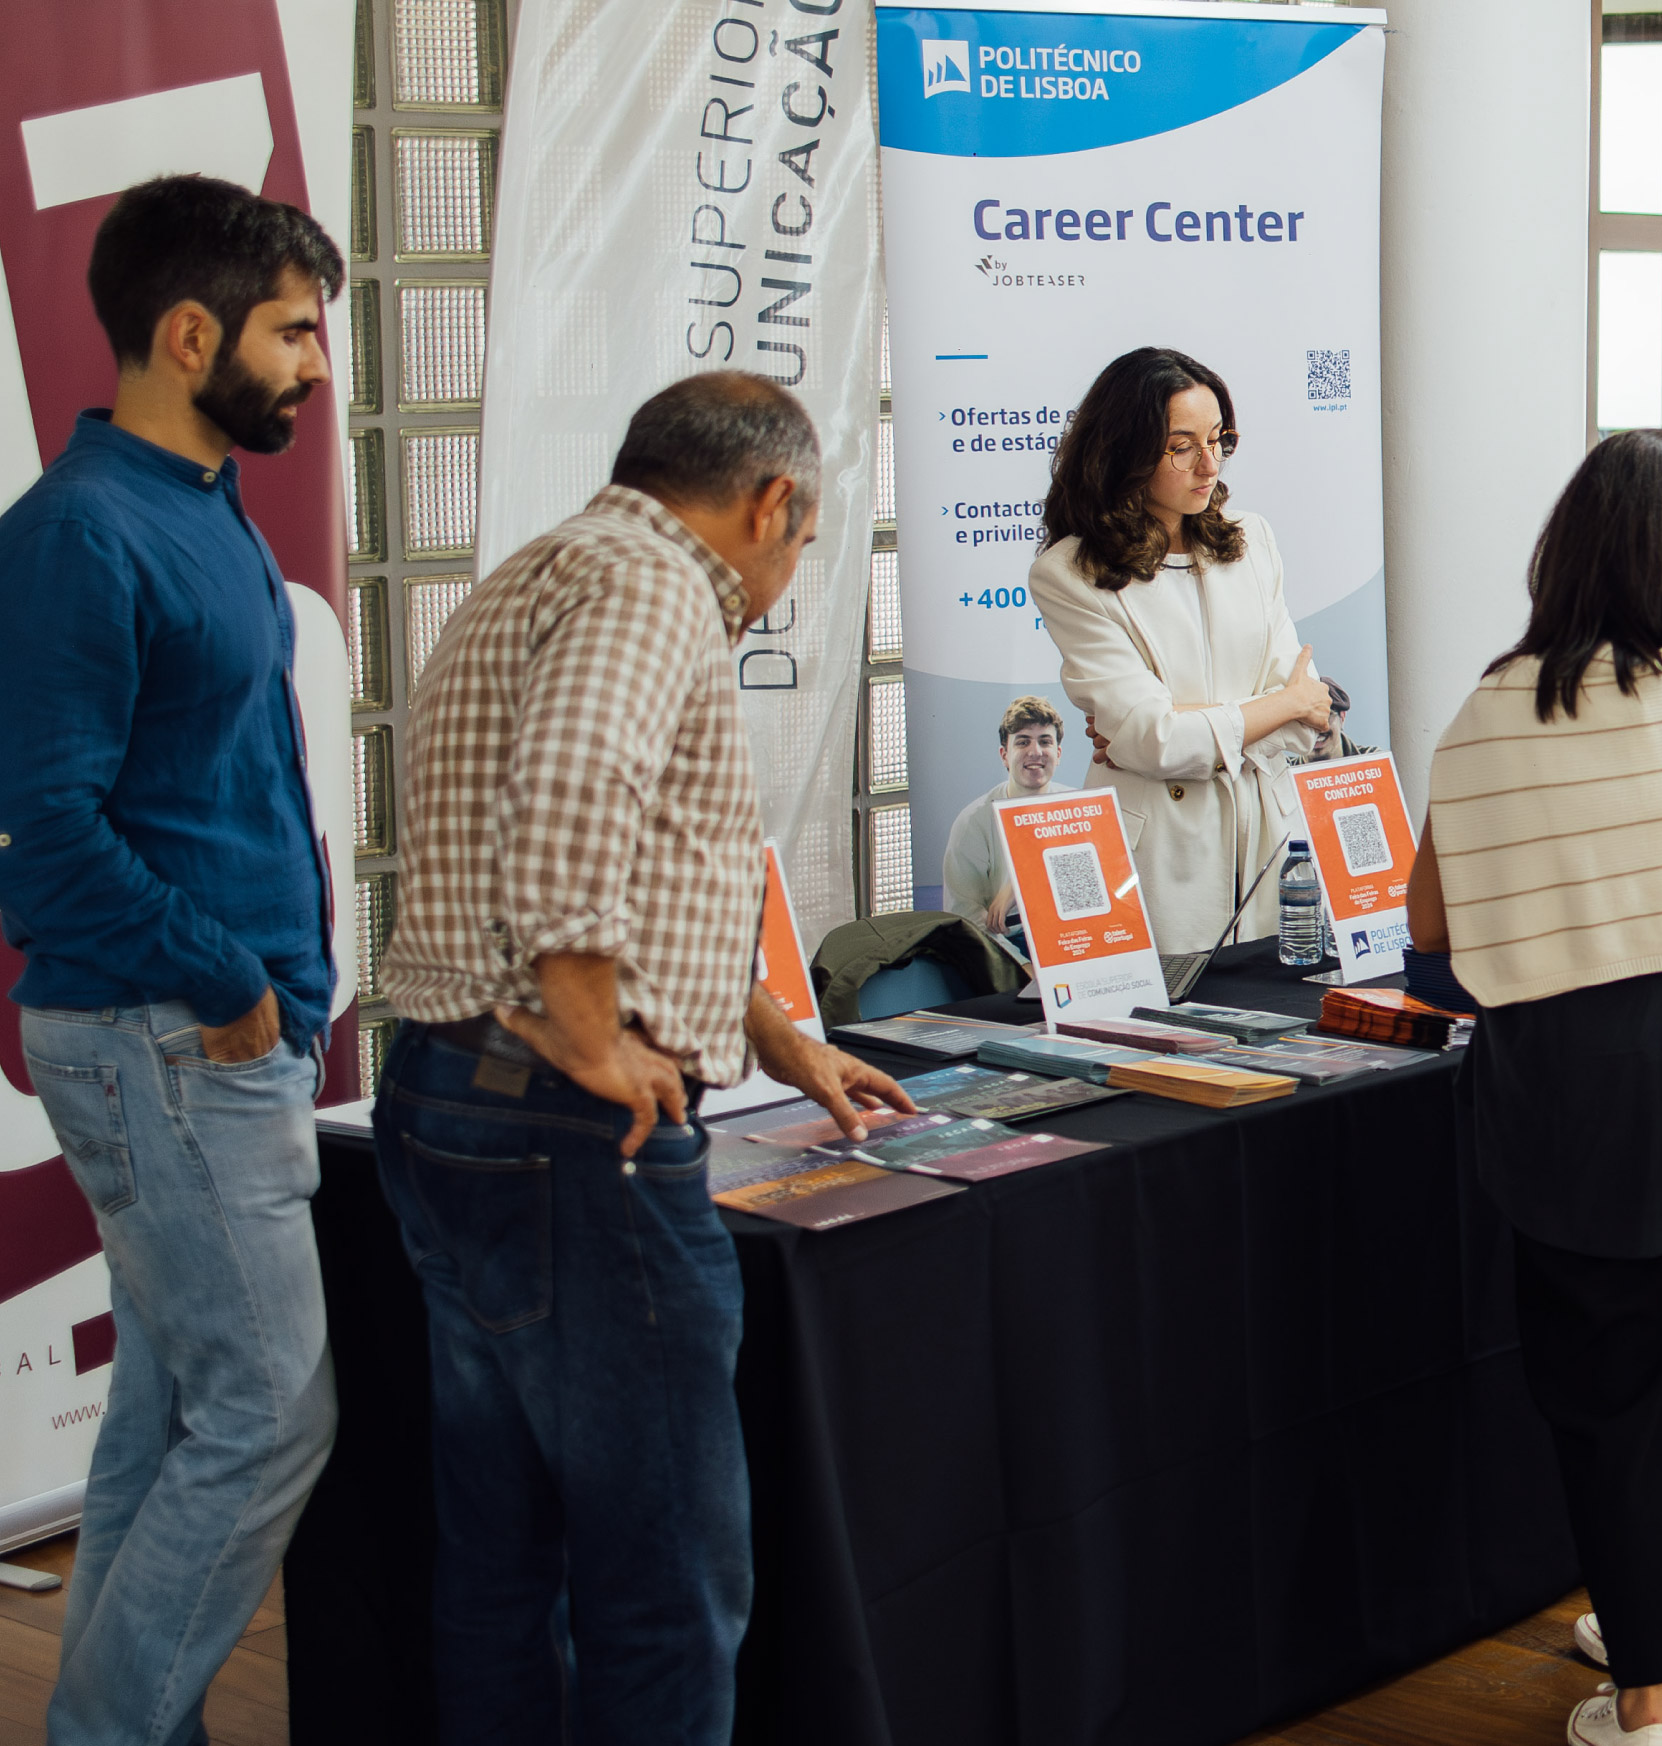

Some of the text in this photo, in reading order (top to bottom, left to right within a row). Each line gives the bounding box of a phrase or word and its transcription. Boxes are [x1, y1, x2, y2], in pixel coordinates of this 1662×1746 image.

[979, 43, 1142, 73] POLITÉCNICO
[981, 75, 1110, 100] DE LISBOA
[687, 0, 764, 362] SUPERIO
[757, 0, 843, 387] UNICAÇÃ
[973, 199, 1304, 243] Career Center
[995, 259, 1008, 271] by
[992, 274, 1086, 287] JOBTEASER
[951, 407, 1031, 426] Ofertas
[1036, 406, 1061, 424] de
[952, 438, 965, 453] e
[970, 434, 996, 452] de
[954, 500, 1044, 520] Contacto
[956, 529, 968, 544] e
[1306, 767, 1382, 791] DEIXE AQUI O SEU
[1324, 782, 1374, 801] CONTACTO
[1013, 804, 1103, 827] DEIXE AQUI O SEU
[1034, 820, 1092, 839] CONTACTO
[1373, 941, 1388, 955] DE
